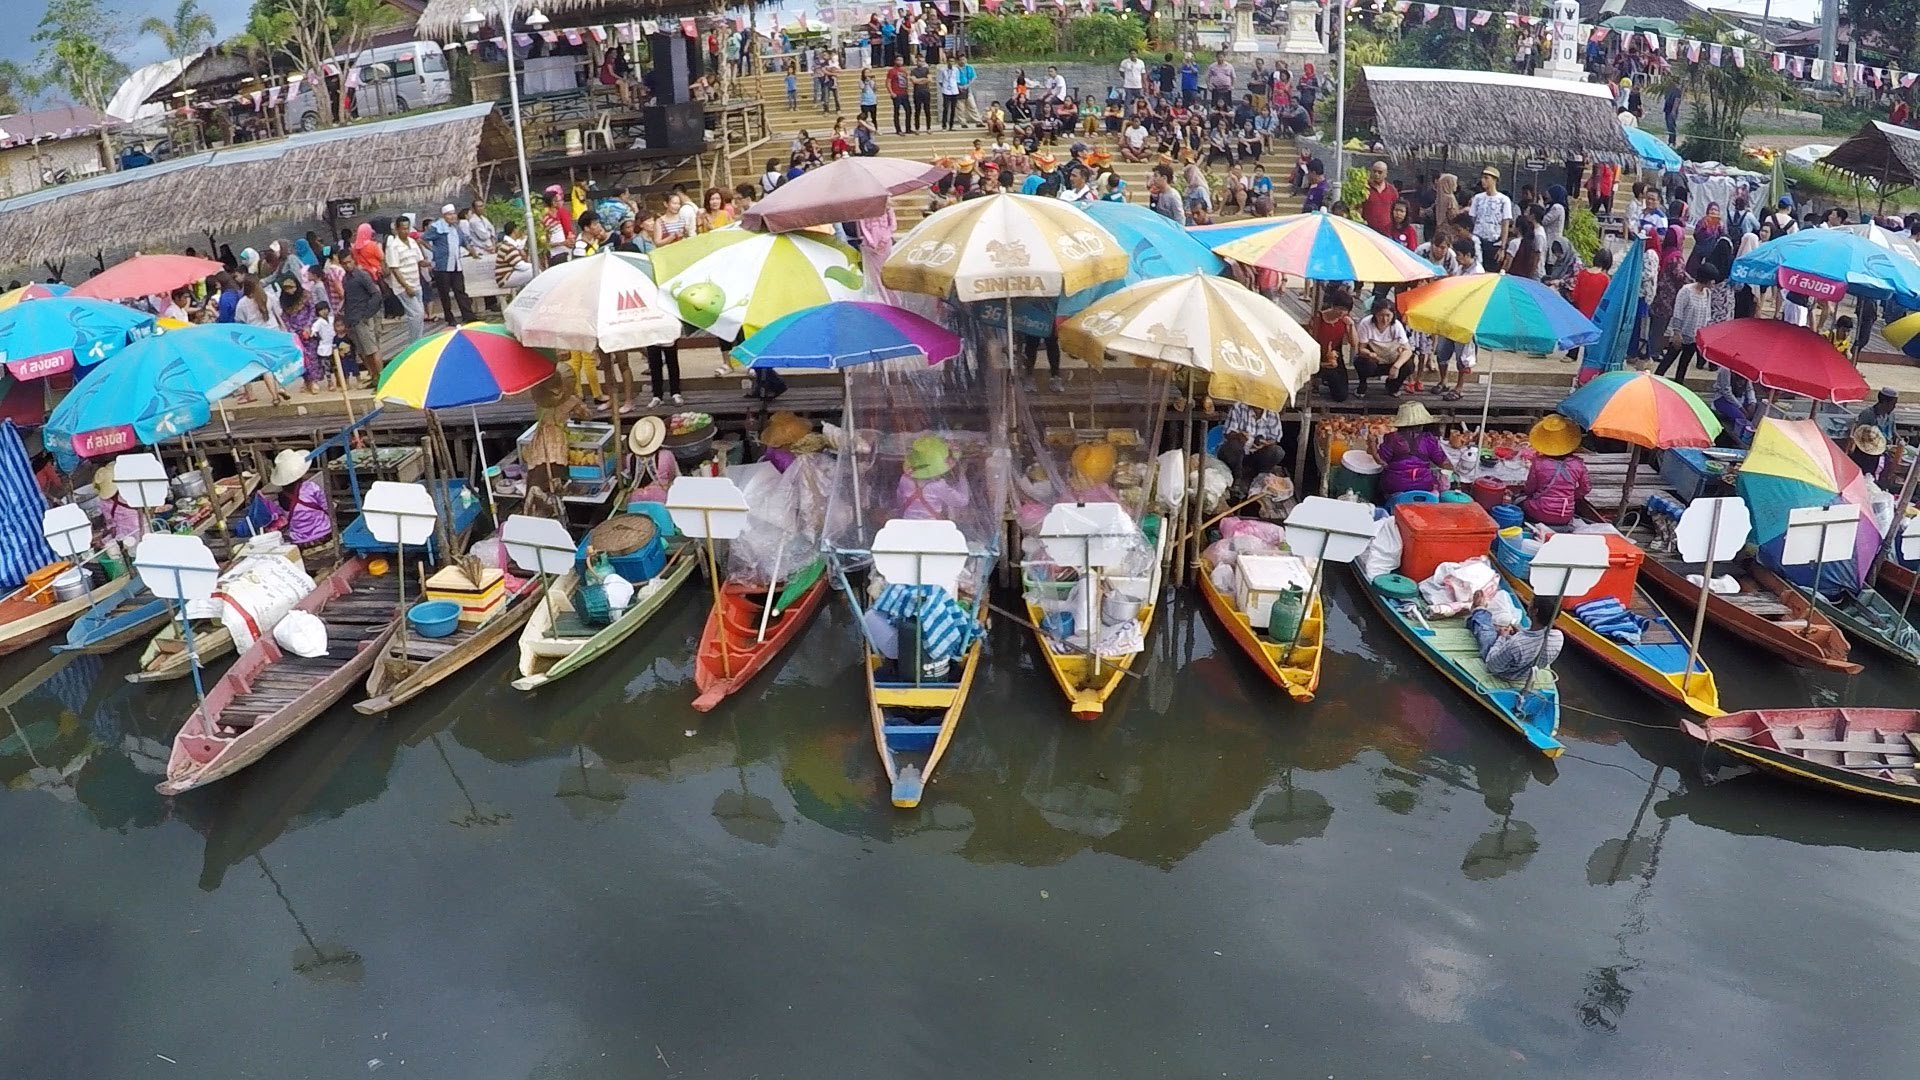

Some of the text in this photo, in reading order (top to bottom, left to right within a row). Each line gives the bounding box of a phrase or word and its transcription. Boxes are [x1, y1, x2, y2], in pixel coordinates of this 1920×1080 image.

[1563, 47, 1572, 60] 0
[973, 276, 1046, 294] SINGHA
[1799, 277, 1836, 295] สงขลา
[29, 355, 65, 373] สงขลา
[95, 431, 127, 448] สงขลา
